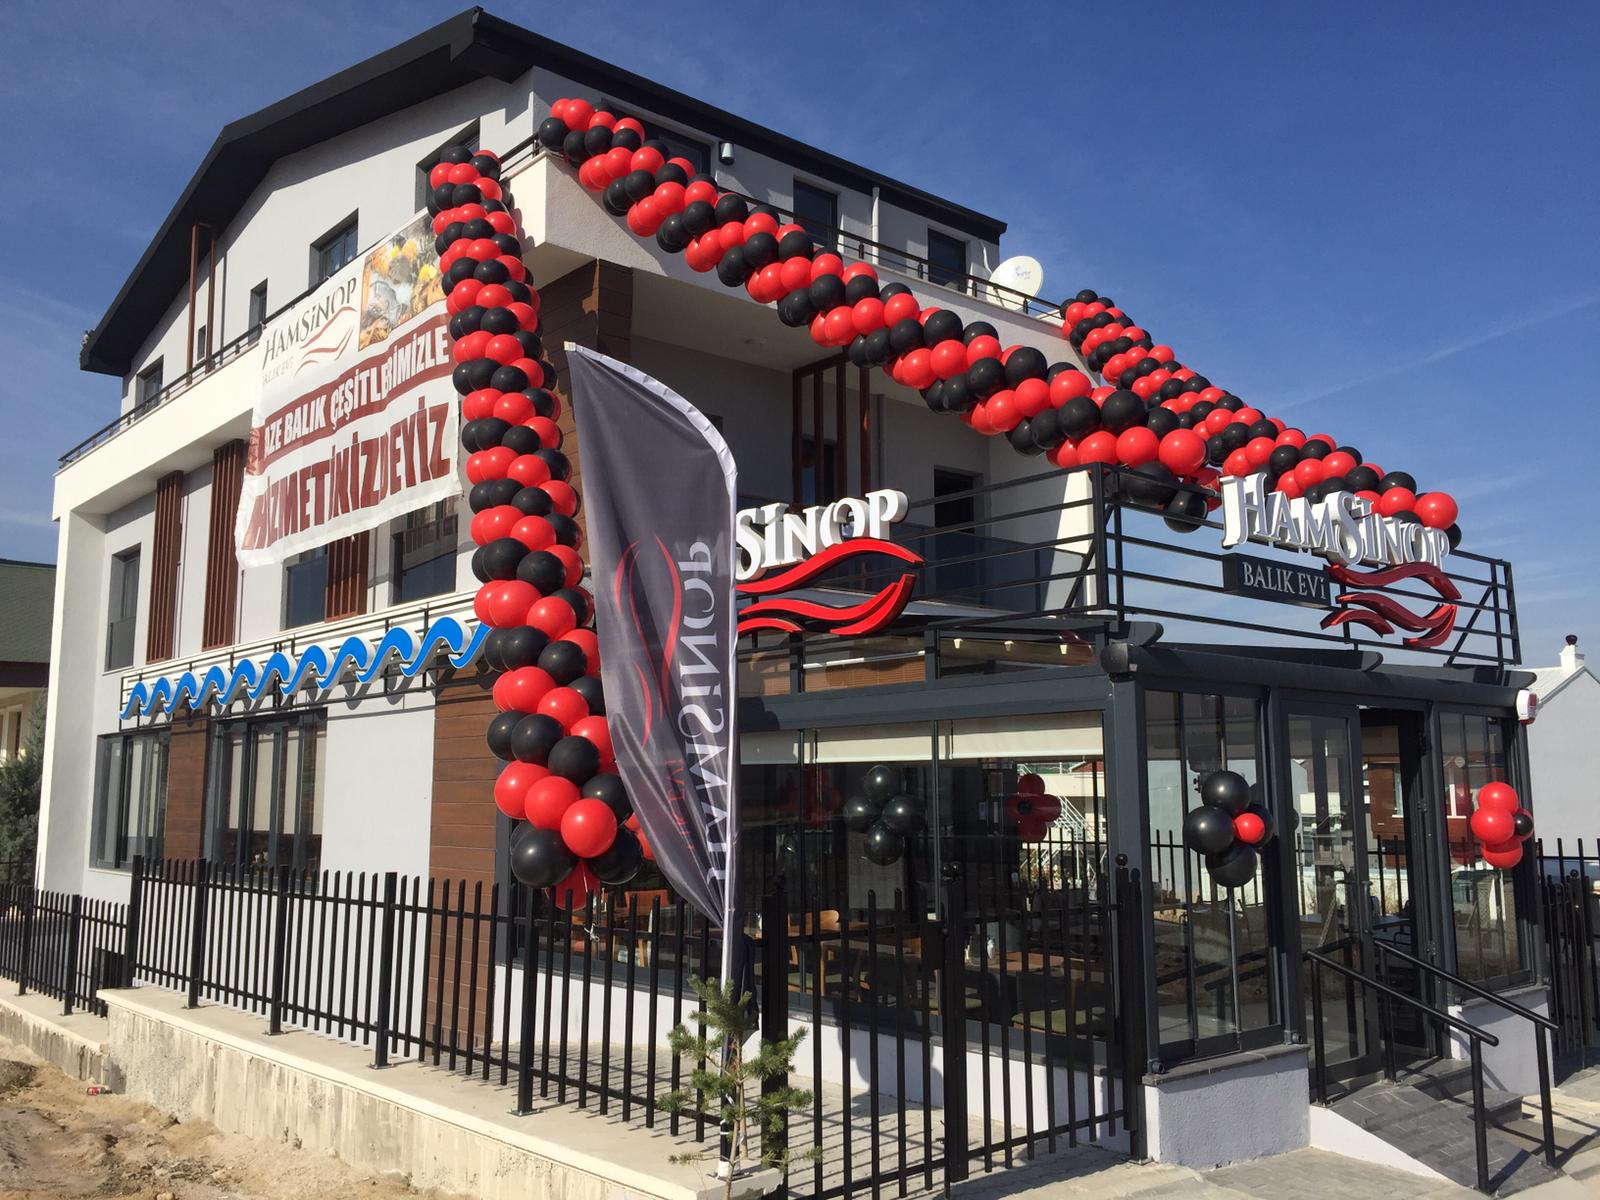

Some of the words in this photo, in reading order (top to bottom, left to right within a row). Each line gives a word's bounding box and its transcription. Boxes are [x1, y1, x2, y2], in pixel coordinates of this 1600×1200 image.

[284, 394, 326, 441] BALIK
[735, 489, 909, 581] SİNOP
[1242, 562, 1296, 595] BALIK
